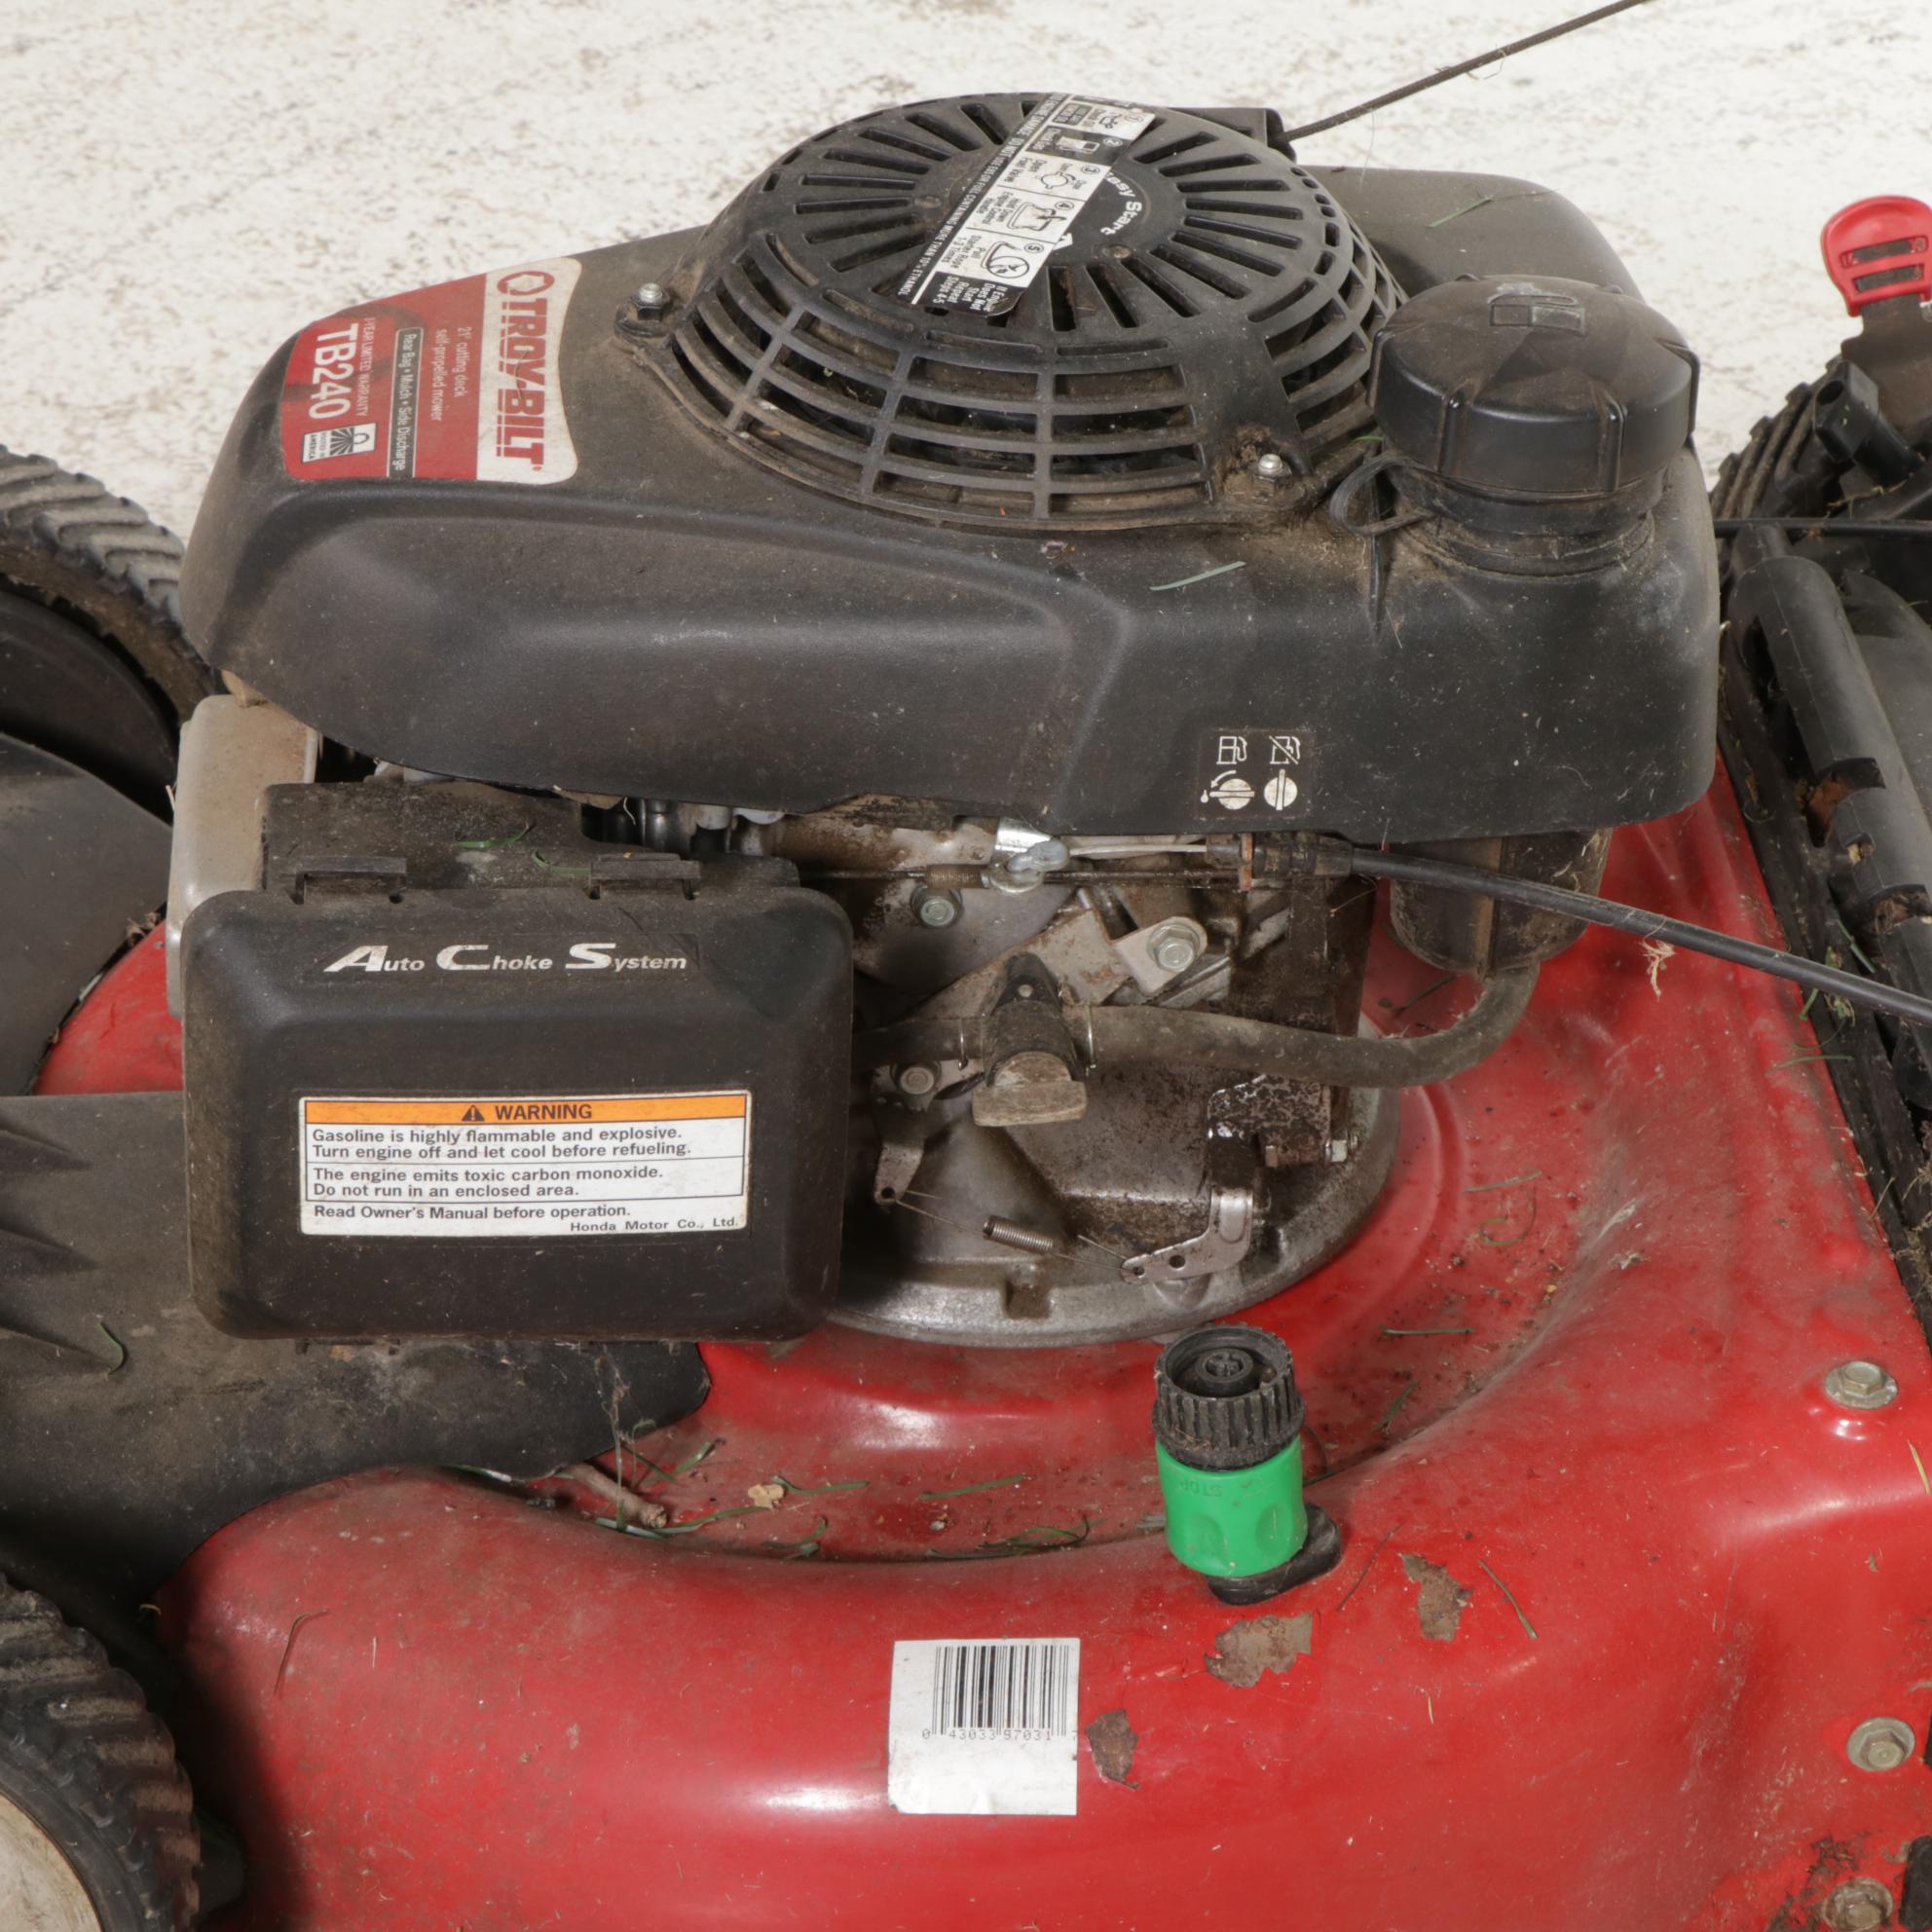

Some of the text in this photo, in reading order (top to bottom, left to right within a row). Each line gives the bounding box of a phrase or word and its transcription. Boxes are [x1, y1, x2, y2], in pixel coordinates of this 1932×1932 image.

[1100, 171, 1142, 236] asy Start
[925, 242, 943, 258] THAN
[950, 235, 983, 269] Starter Rope
[971, 246, 986, 259] Pull
[898, 269, 923, 295] ETHANOL
[939, 276, 959, 293] Steps
[947, 281, 970, 304] Repeat
[977, 282, 996, 298] Does
[961, 286, 980, 302] Start
[359, 341, 374, 370] LIMITED
[453, 342, 469, 373] cutting
[308, 323, 358, 419] TB240
[430, 329, 449, 421] self-propelled mower
[497, 298, 547, 464] TROY-BILT
[356, 372, 371, 416] WARRANTY
[454, 375, 467, 396] deck
[392, 333, 417, 470] Rear Bag Mulch Side Discharge
[309, 433, 317, 460] AMERICA
[323, 943, 687, 974] Auto Choke System
[495, 1104, 592, 1120] WARNING
[313, 1127, 682, 1145] Gasoline is highly flammable and explosive.
[313, 1142, 690, 1161] Turn engine off and let cool before refueling.
[314, 1167, 663, 1184] The engine emits toxic carbon monoxide.
[314, 1183, 579, 1197] Do not run in an enclosed area.
[315, 1206, 631, 1221] Read Owner's Manual before operation.
[570, 1218, 738, 1232] Honda Motor Co., Ltd.
[921, 1729, 931, 1740] 0
[948, 1728, 997, 1740] 43033
